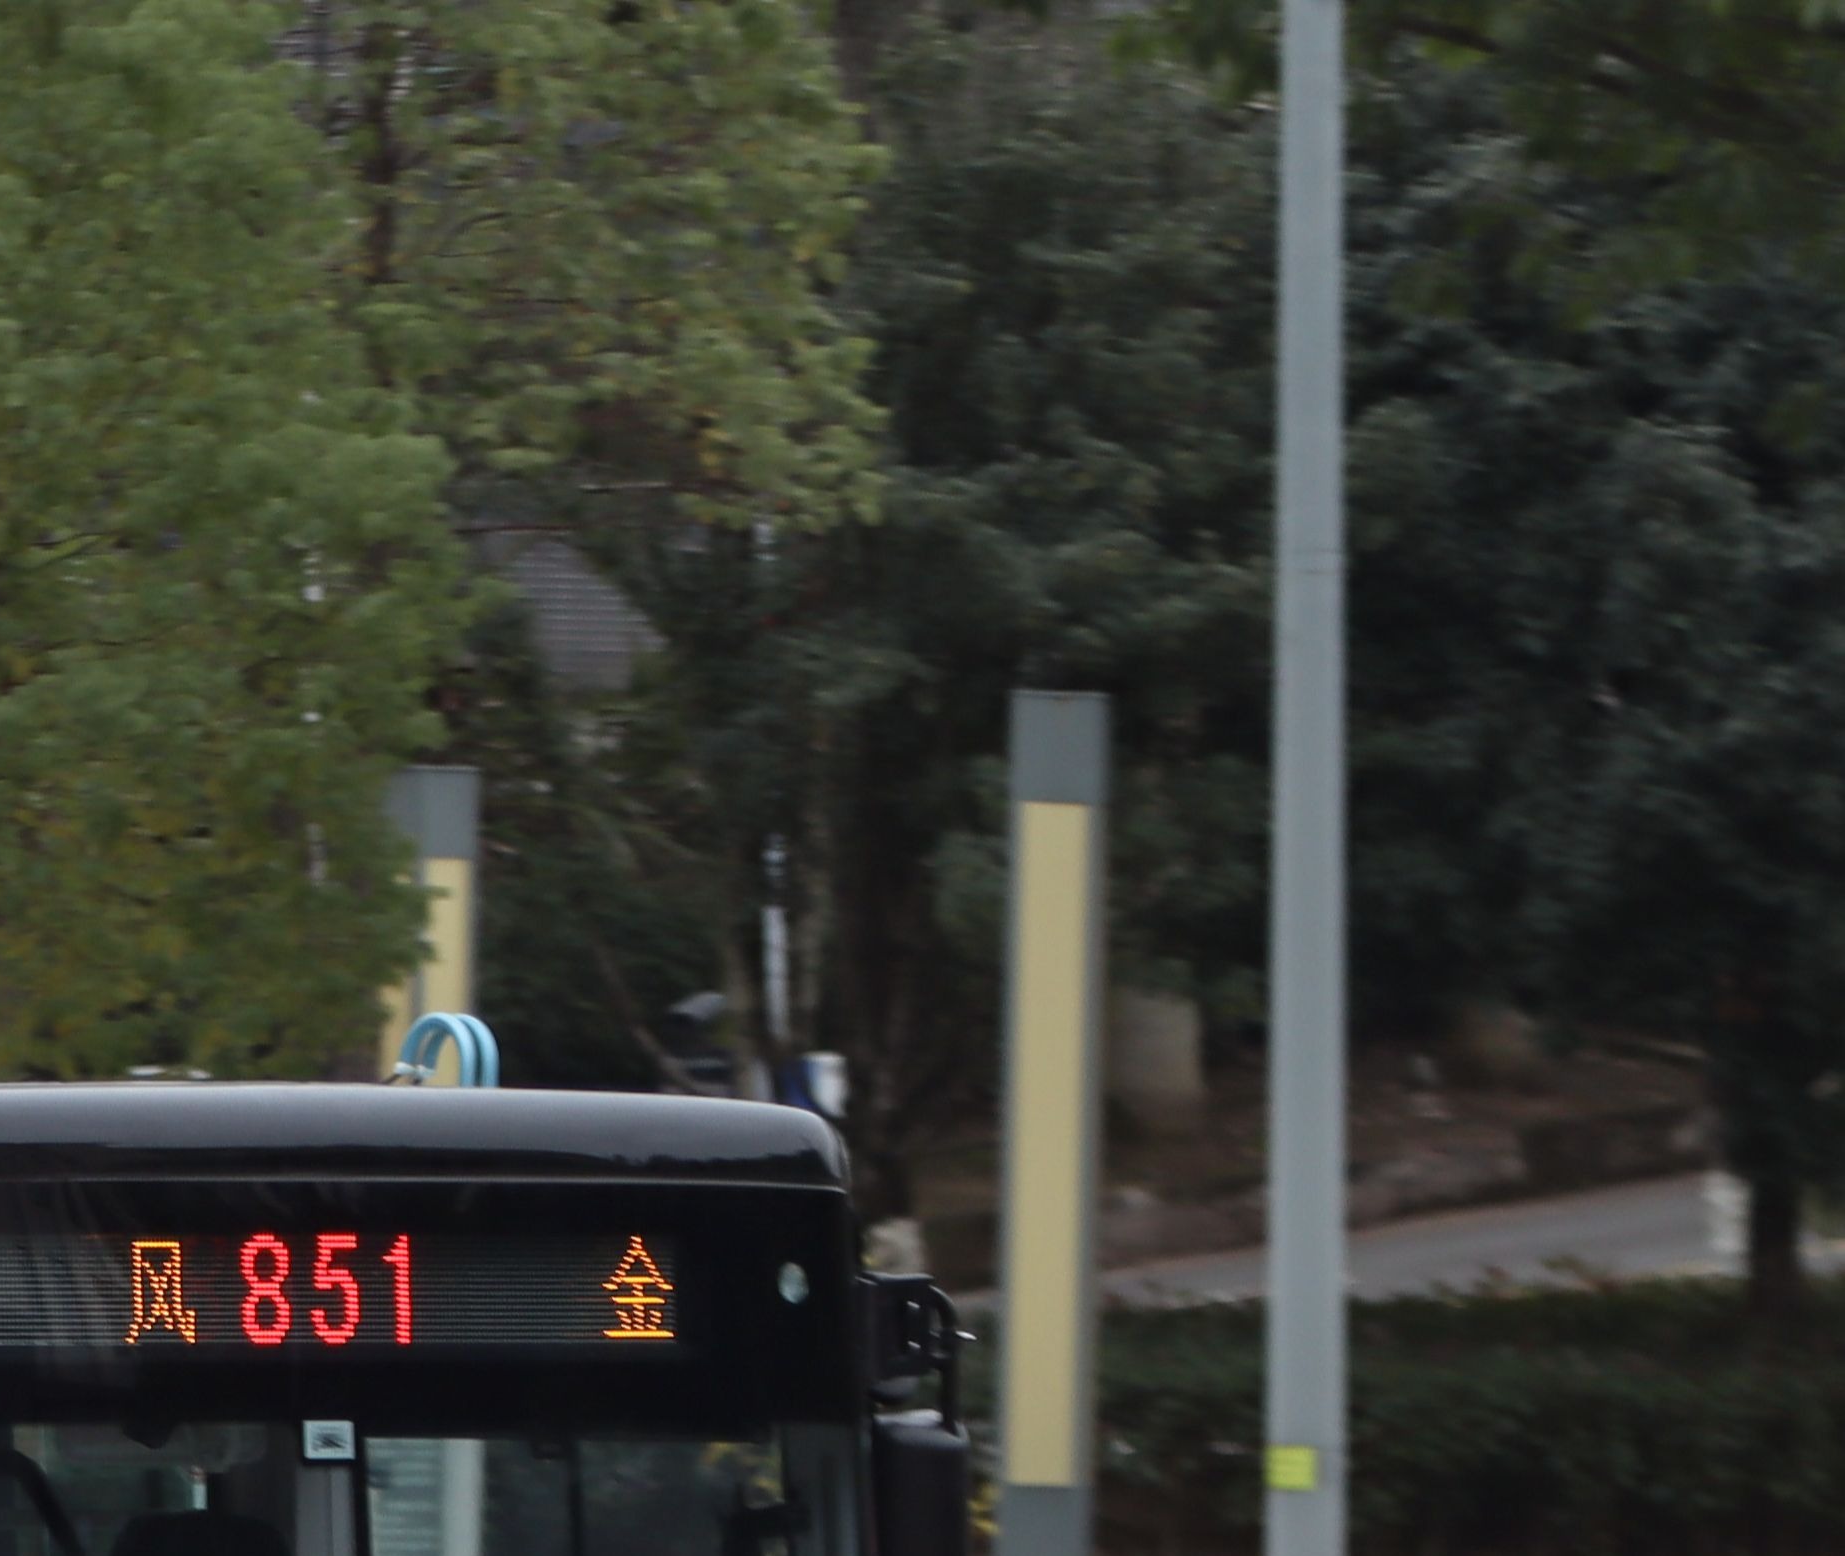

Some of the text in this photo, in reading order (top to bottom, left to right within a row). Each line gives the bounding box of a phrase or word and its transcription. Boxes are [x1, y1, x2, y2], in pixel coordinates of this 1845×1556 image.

[124, 1233, 675, 1344] 风 851 金
